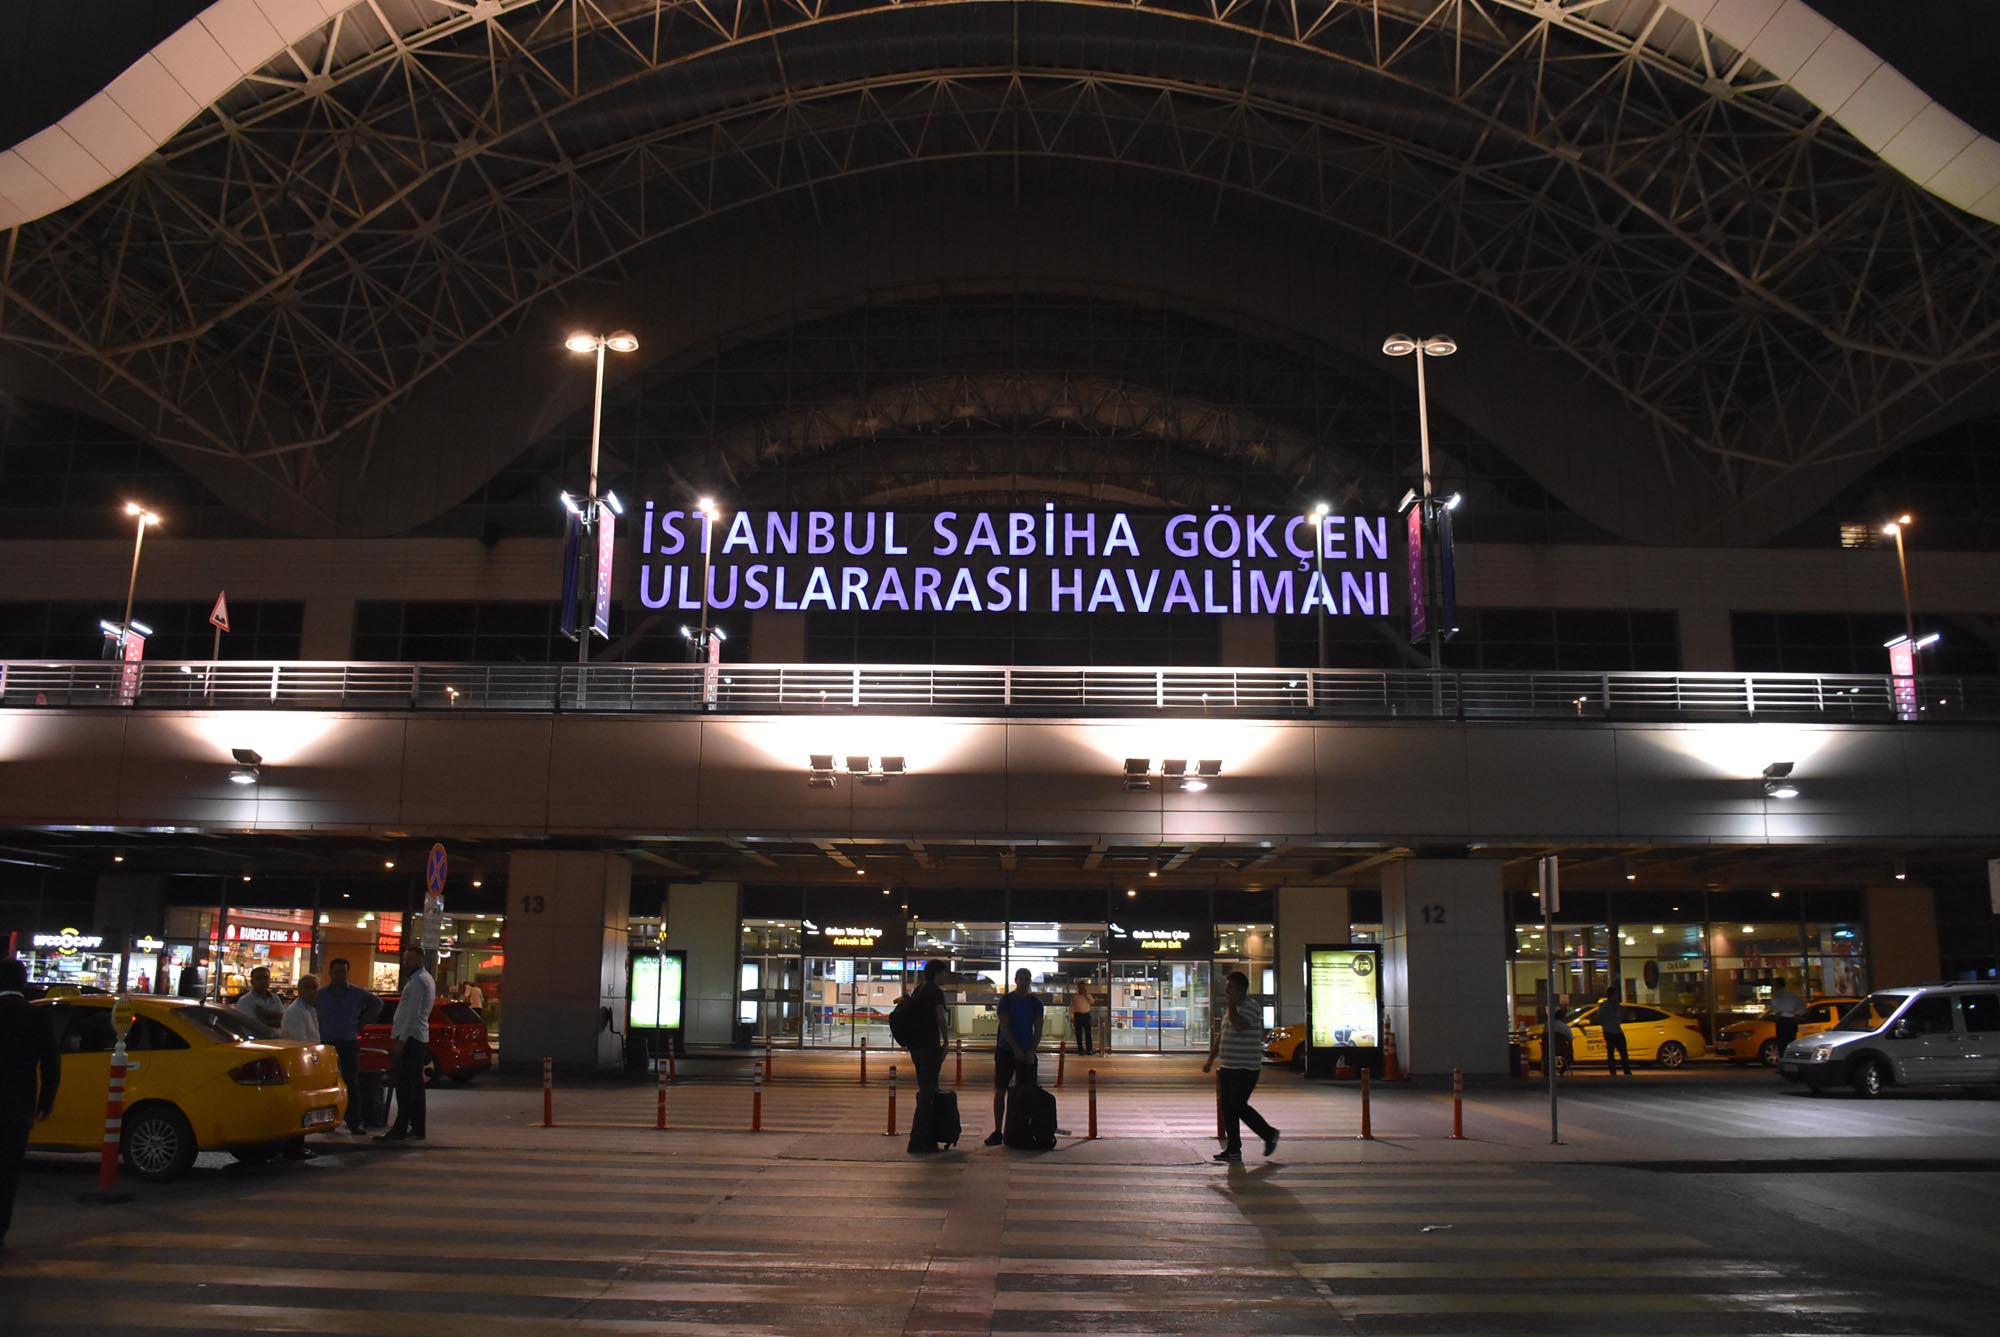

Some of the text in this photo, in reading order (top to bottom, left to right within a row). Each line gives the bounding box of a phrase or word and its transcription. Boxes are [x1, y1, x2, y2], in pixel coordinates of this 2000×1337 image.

[642, 500, 908, 556] İSTANBUL
[933, 503, 1141, 557] SABİHA
[1164, 503, 1388, 572] GÖKÇEN
[640, 564, 1029, 612] ULUSLARARASI
[1051, 560, 1389, 616] HAVALİMANI
[520, 896, 544, 913] 13
[1421, 905, 1445, 924] 12
[240, 927, 288, 941] BURGER KING
[834, 937, 859, 945] Arrivals
[1141, 940, 1181, 948] Arrivals Exit
